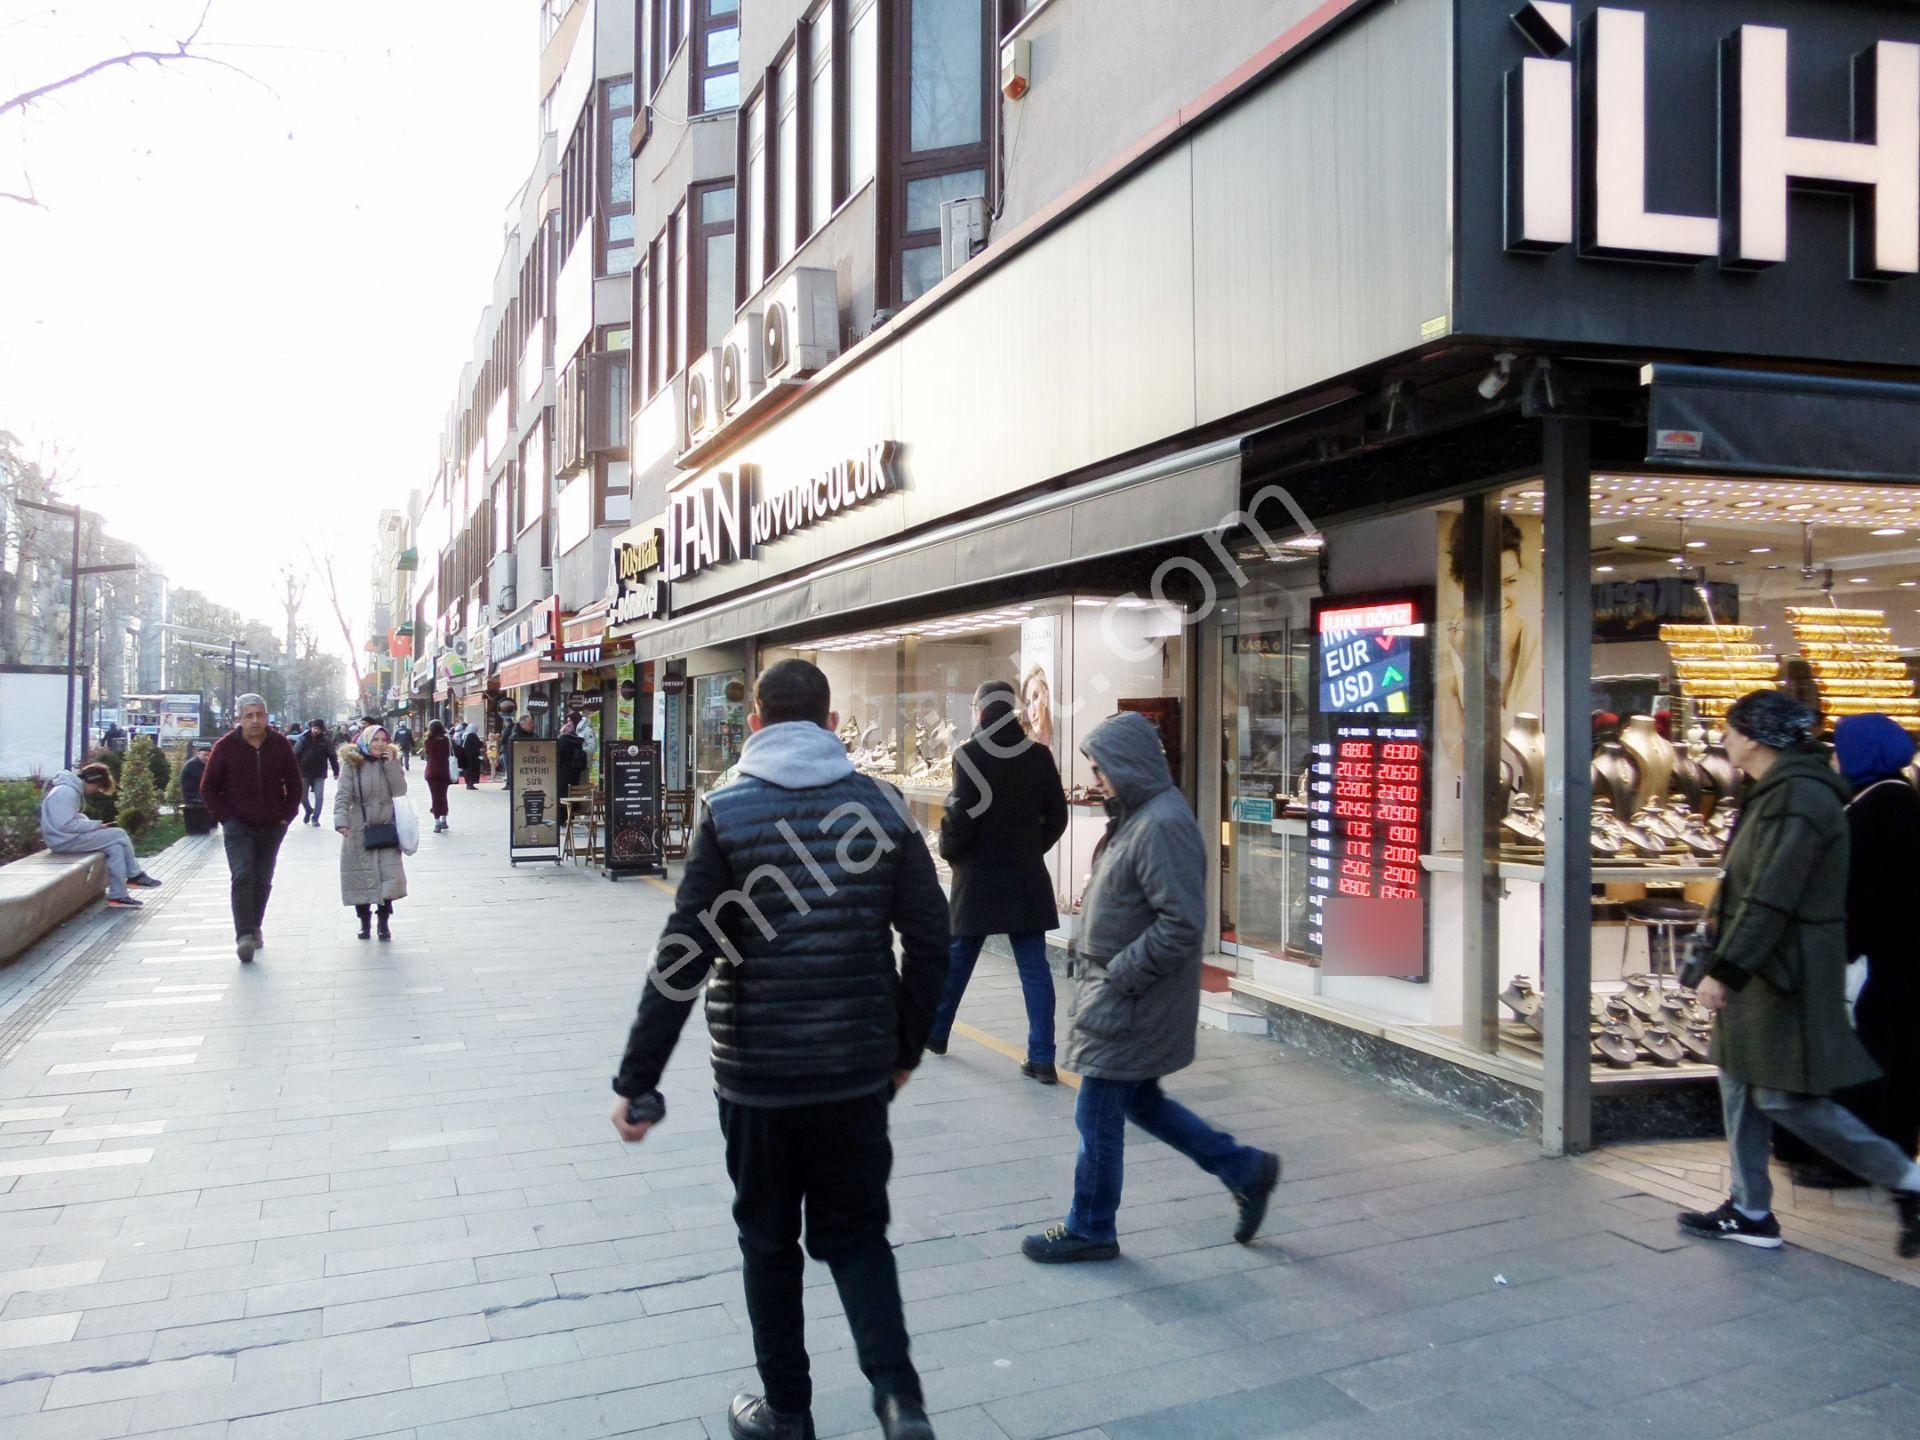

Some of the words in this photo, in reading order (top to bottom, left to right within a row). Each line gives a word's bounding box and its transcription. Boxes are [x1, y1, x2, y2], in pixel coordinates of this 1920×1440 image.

[751, 440, 890, 546] KUYUMCULUK
[1325, 639, 1372, 678] EUR
[1330, 670, 1374, 707] USD
